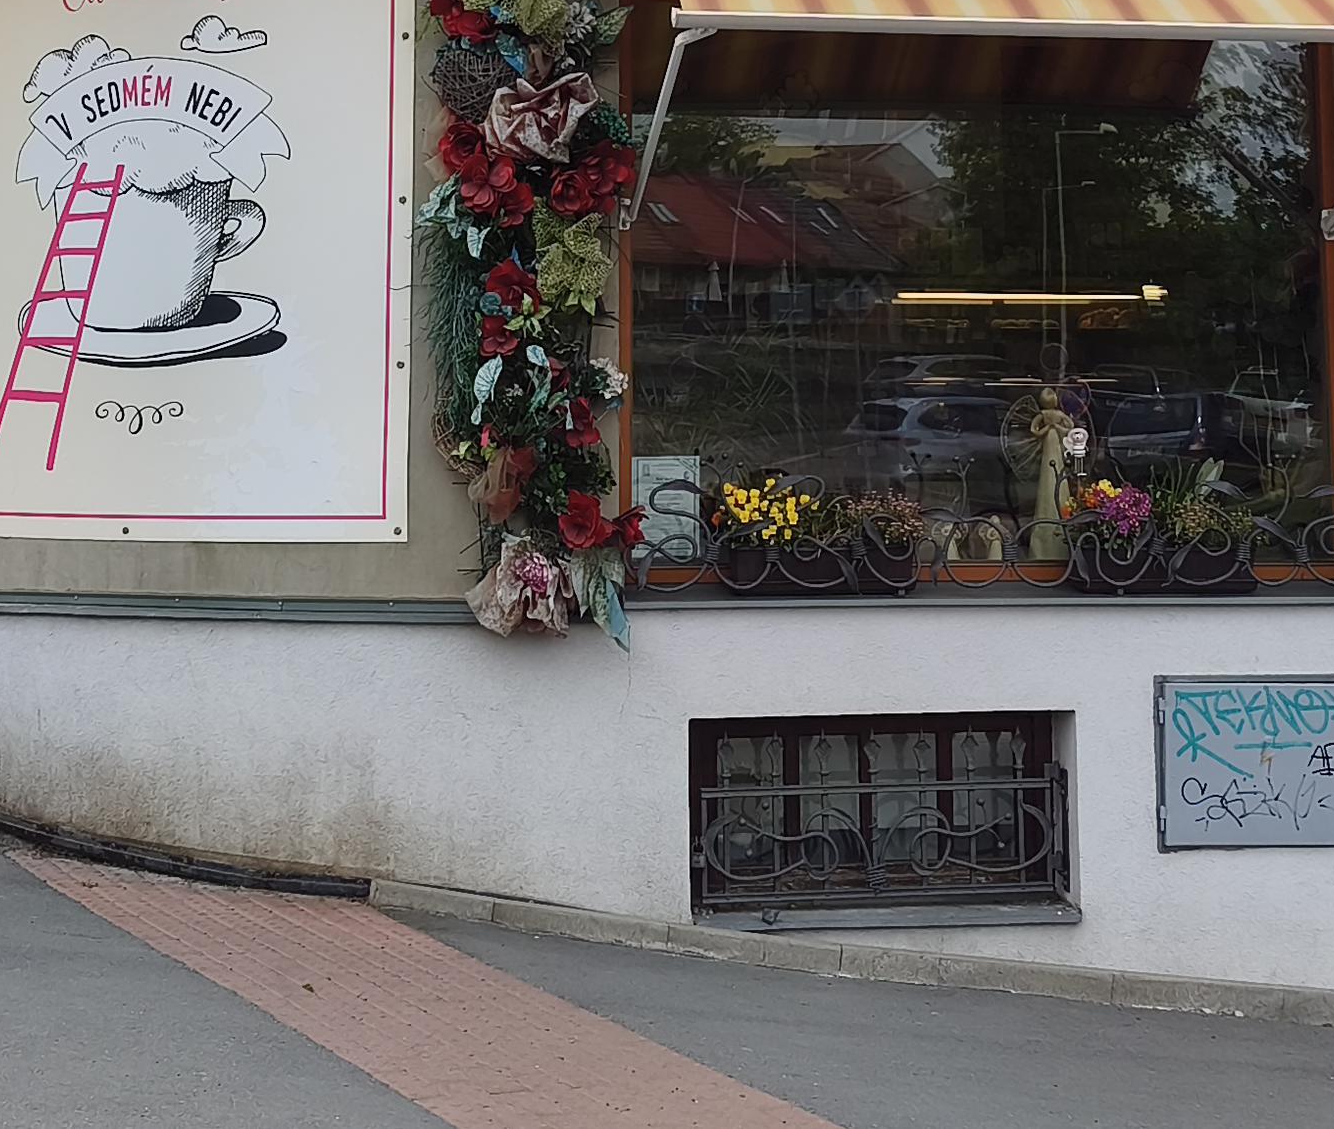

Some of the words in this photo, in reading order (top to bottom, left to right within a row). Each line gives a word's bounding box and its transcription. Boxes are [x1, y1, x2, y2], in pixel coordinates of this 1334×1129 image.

[44, 112, 73, 141] V
[81, 64, 173, 123] SEDMÉM
[184, 81, 242, 133] NEBI
